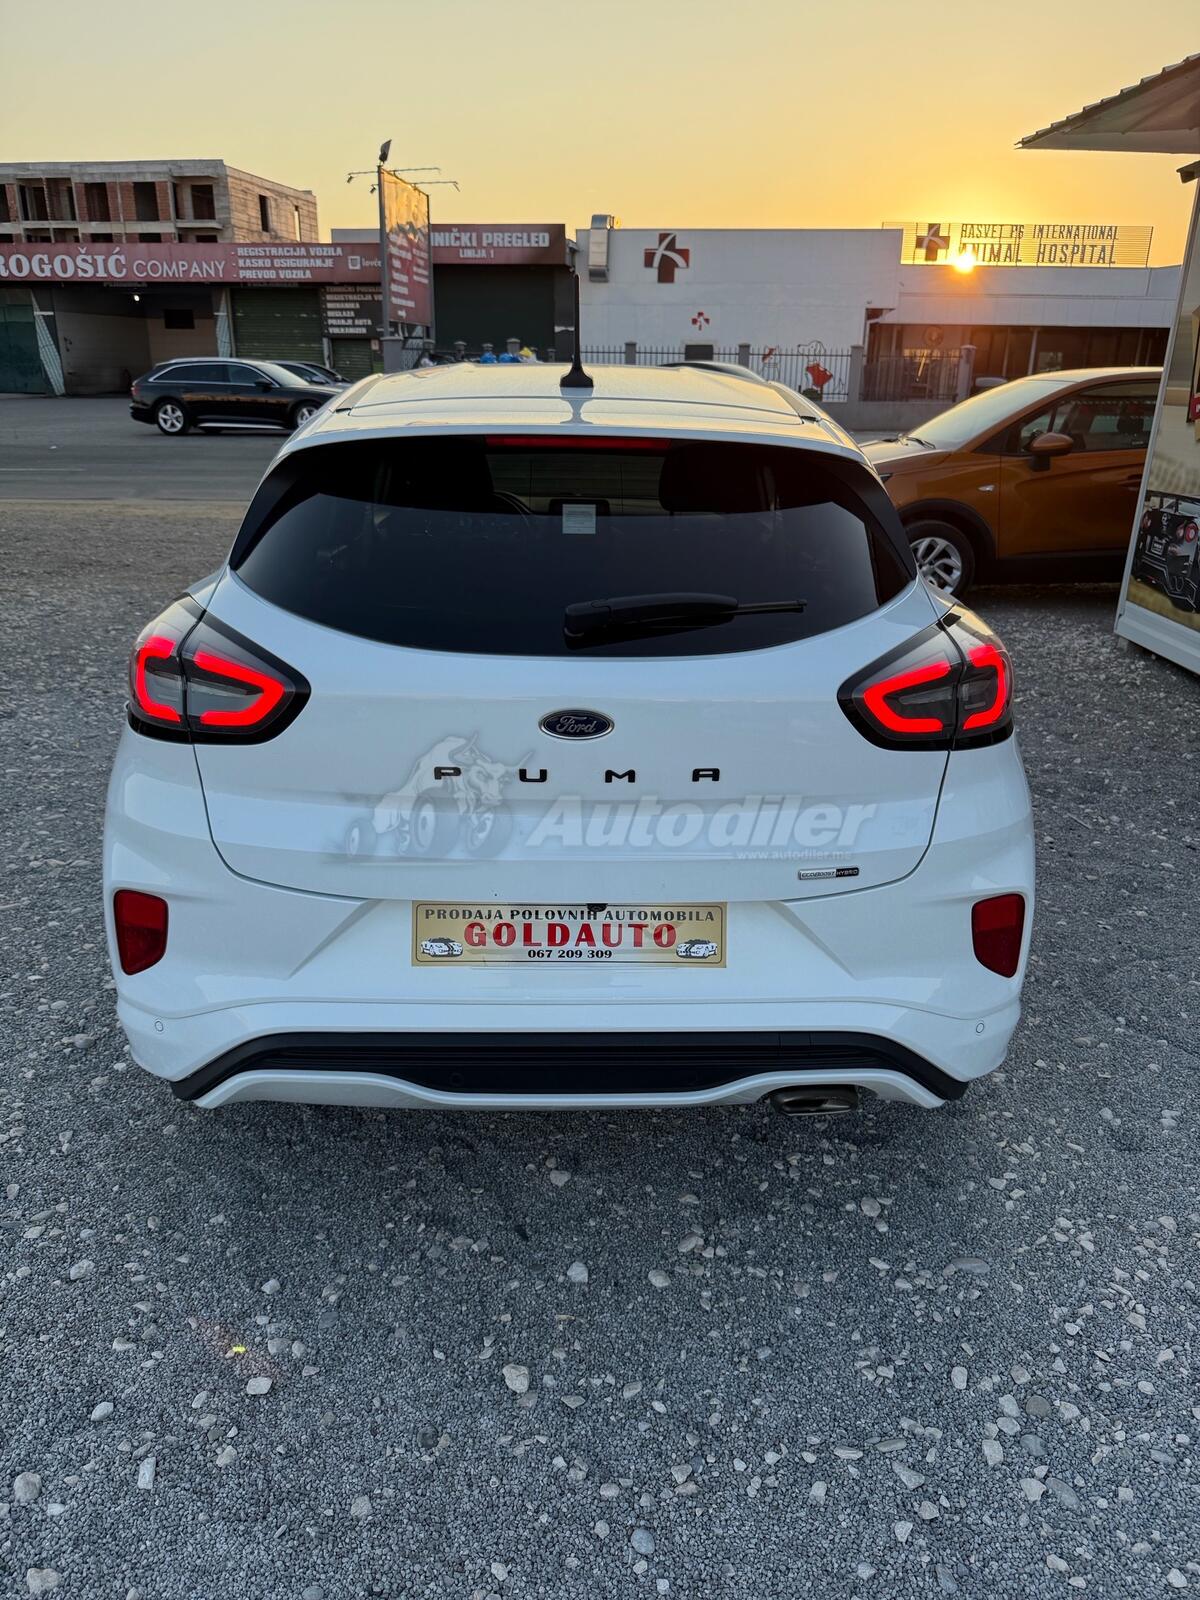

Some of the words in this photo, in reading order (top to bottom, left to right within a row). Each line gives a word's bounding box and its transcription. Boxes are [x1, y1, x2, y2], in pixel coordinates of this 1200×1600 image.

[482, 232, 550, 247] PREGLED
[1032, 224, 1118, 240] INTERNATIONAL
[237, 247, 306, 256] REGISTRACIJA
[309, 247, 343, 257] VOZILA
[459, 249, 487, 258] LINIJA
[1036, 244, 1116, 264] HOSPITAL
[133, 260, 225, 278] COMPANY
[238, 259, 271, 268] KASKO
[274, 259, 334, 268] OSIGURANJE
[279, 270, 312, 279] VOZILA
[556, 715, 597, 733] Ford
[433, 766, 721, 784] PUMA
[424, 909, 504, 921] PRODAJA
[510, 909, 598, 921] POLOVNIH
[603, 910, 715, 922] AUTOMOBILA
[463, 921, 678, 948] GOLDAUTO
[527, 949, 553, 959] 067
[557, 949, 583, 959] 209
[587, 949, 613, 959] 309
